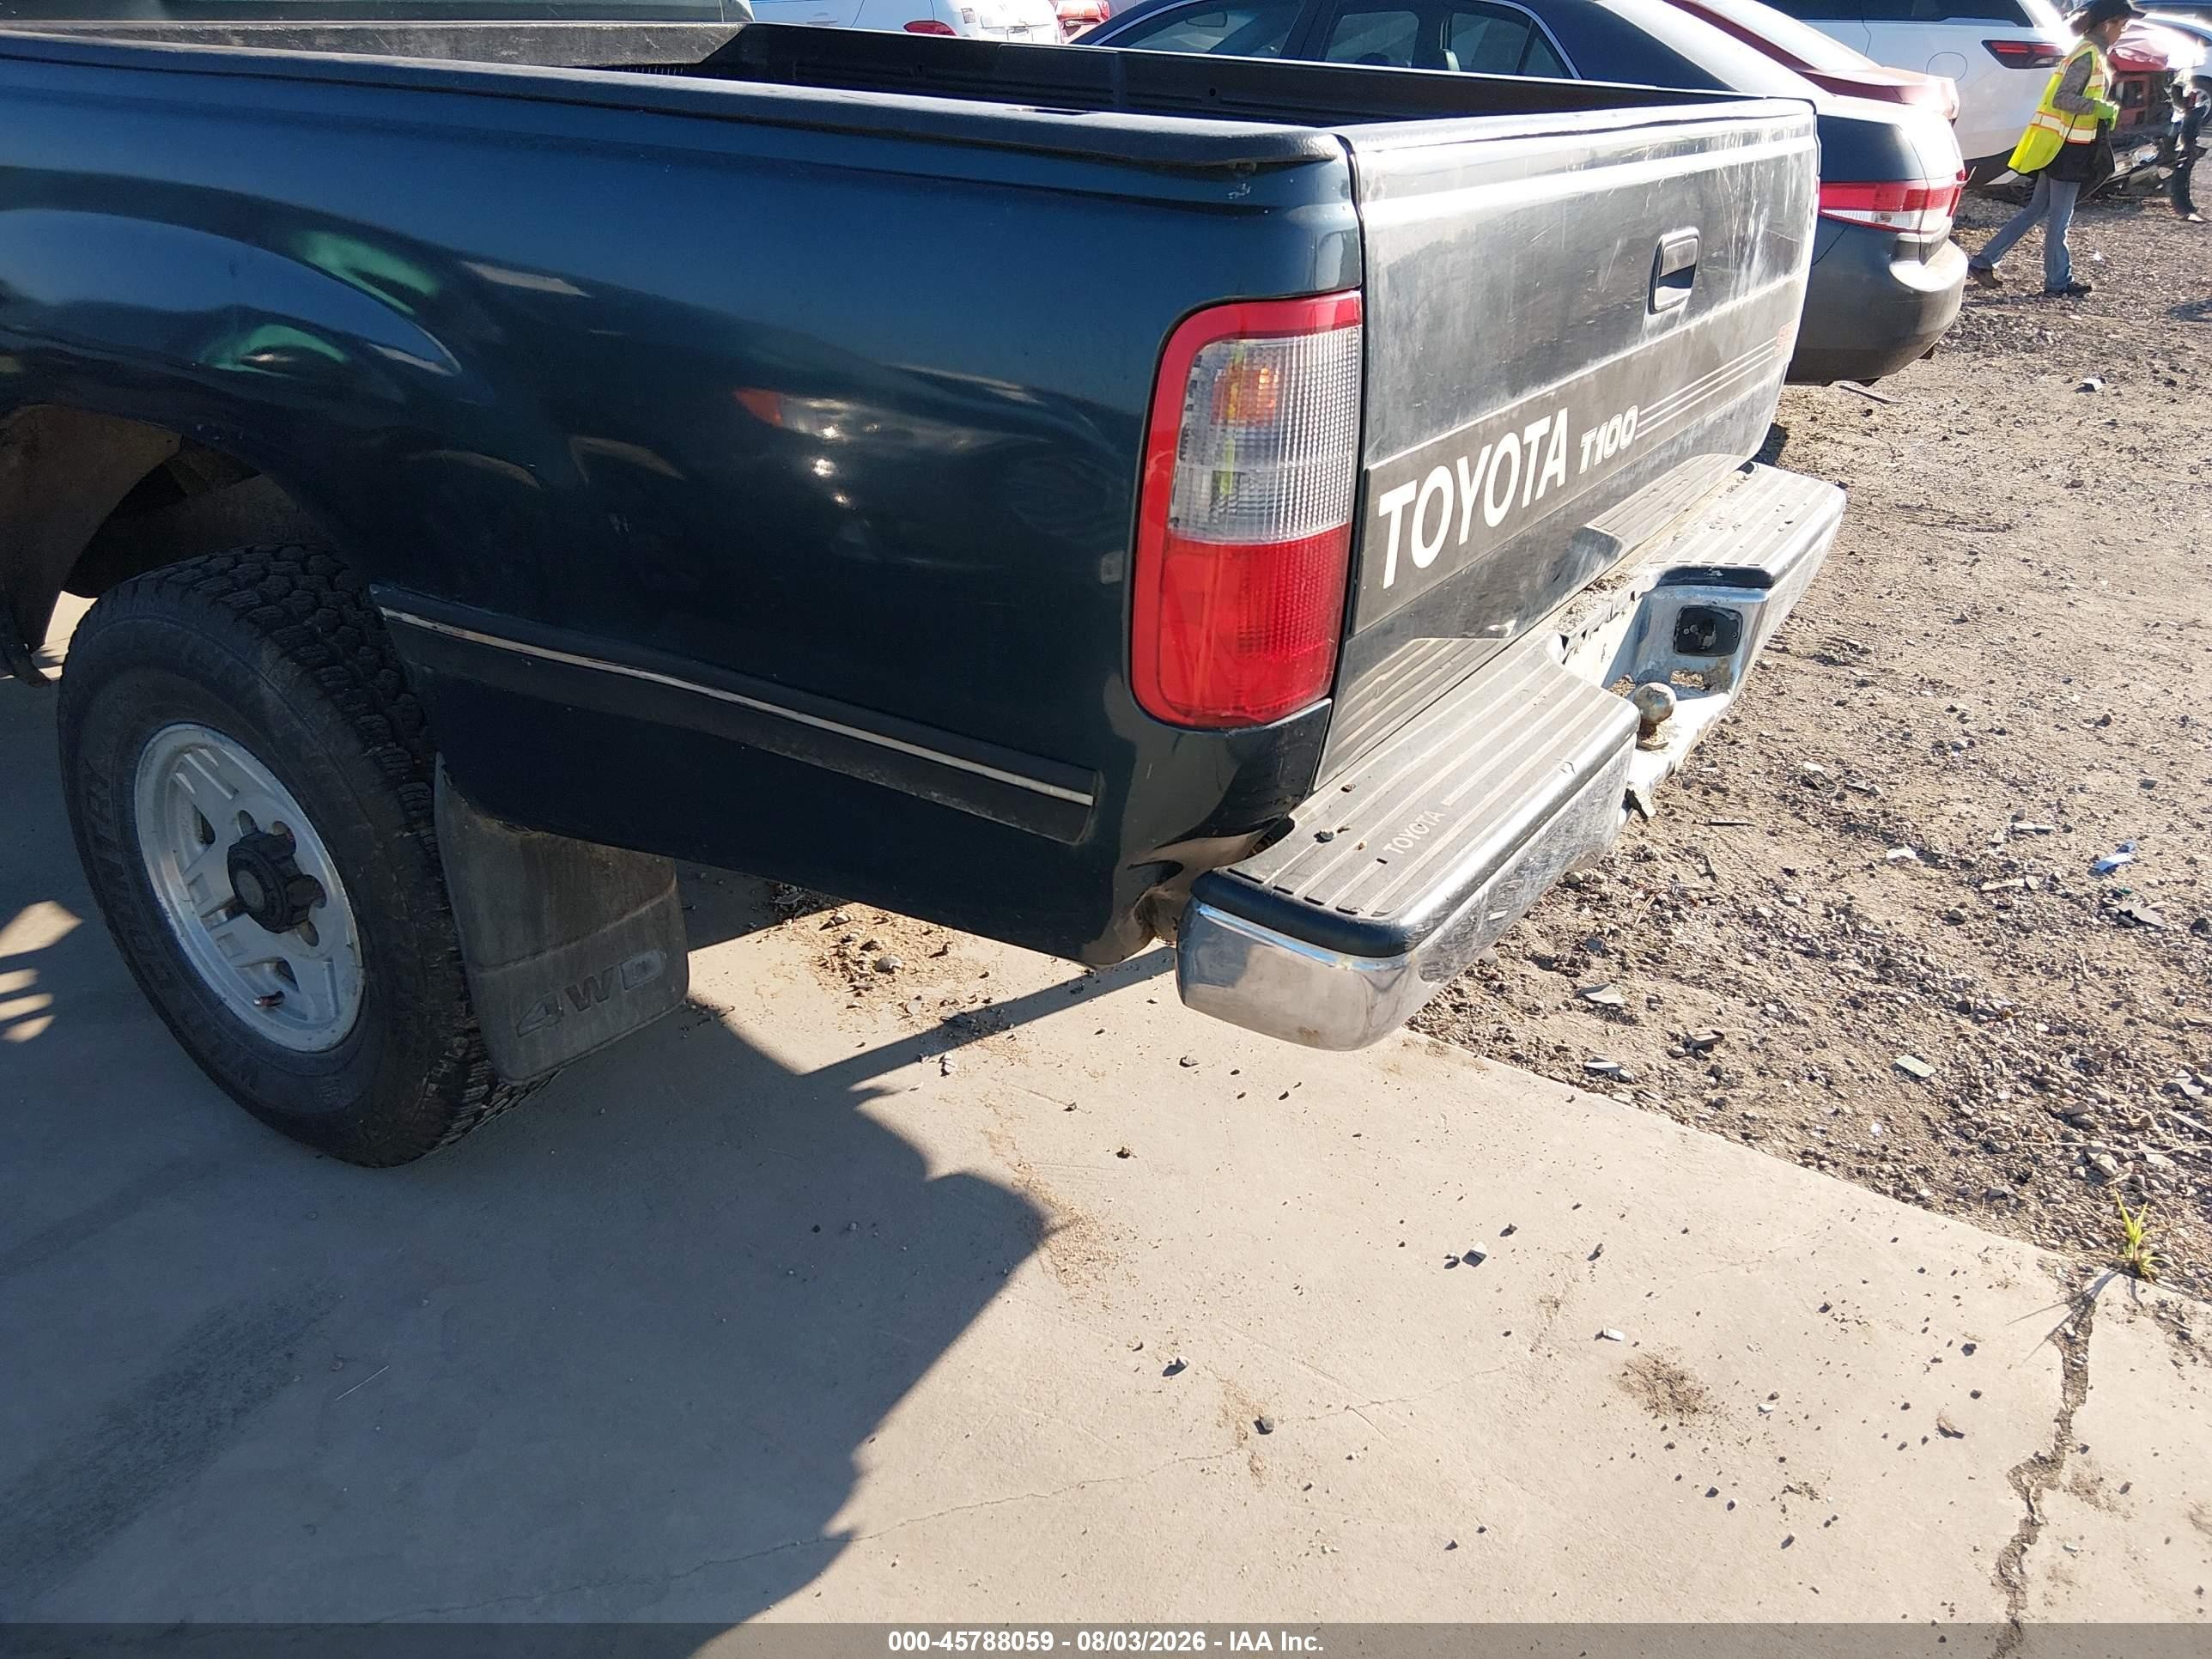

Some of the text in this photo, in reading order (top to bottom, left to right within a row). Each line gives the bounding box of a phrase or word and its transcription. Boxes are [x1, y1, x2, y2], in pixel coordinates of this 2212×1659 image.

[1378, 404, 1639, 590] TOYOTA T100
[1382, 810, 1447, 854] TOYOTA
[516, 949, 665, 1038] 4WD
